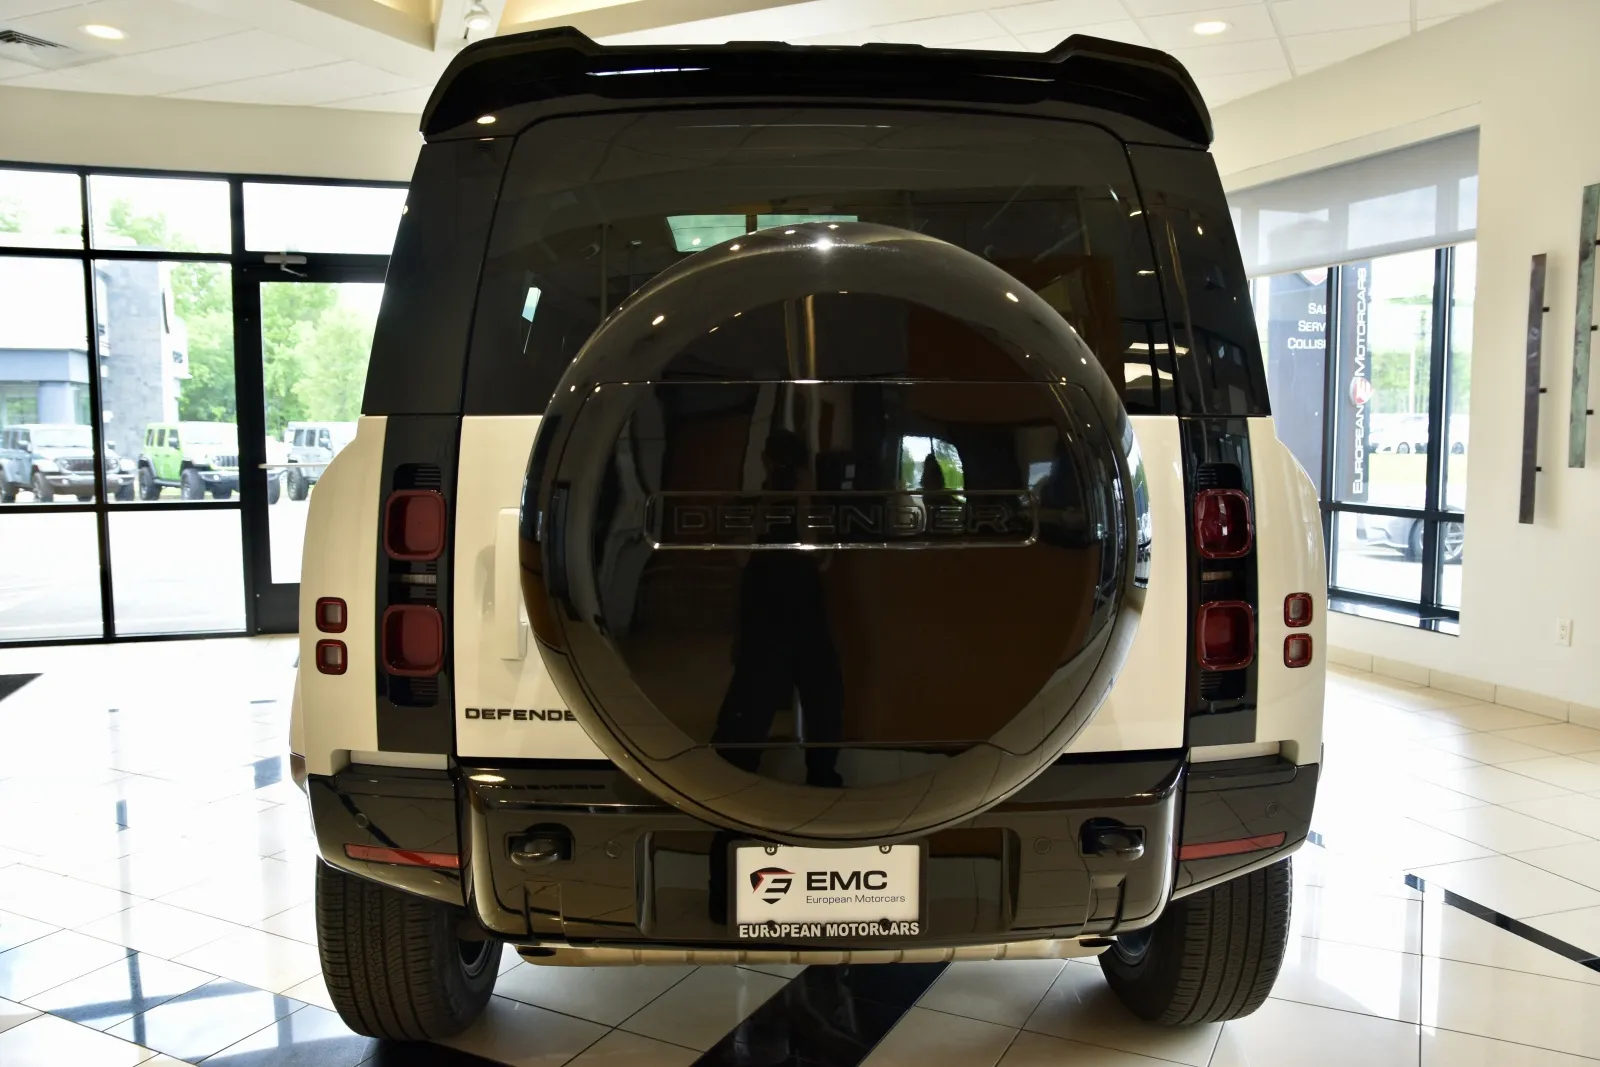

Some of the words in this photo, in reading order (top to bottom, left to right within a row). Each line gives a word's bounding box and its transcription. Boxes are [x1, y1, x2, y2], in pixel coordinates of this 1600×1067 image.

[1354, 267, 1367, 377] MOTORCARS
[1353, 404, 1365, 494] EUROPEAN
[673, 504, 1012, 536] DEFENDER
[806, 870, 888, 892] EMC
[806, 895, 853, 906] European
[854, 894, 906, 904] Motorcars
[738, 923, 822, 938] EUROPEAN
[825, 921, 920, 937] MOTORCARS
